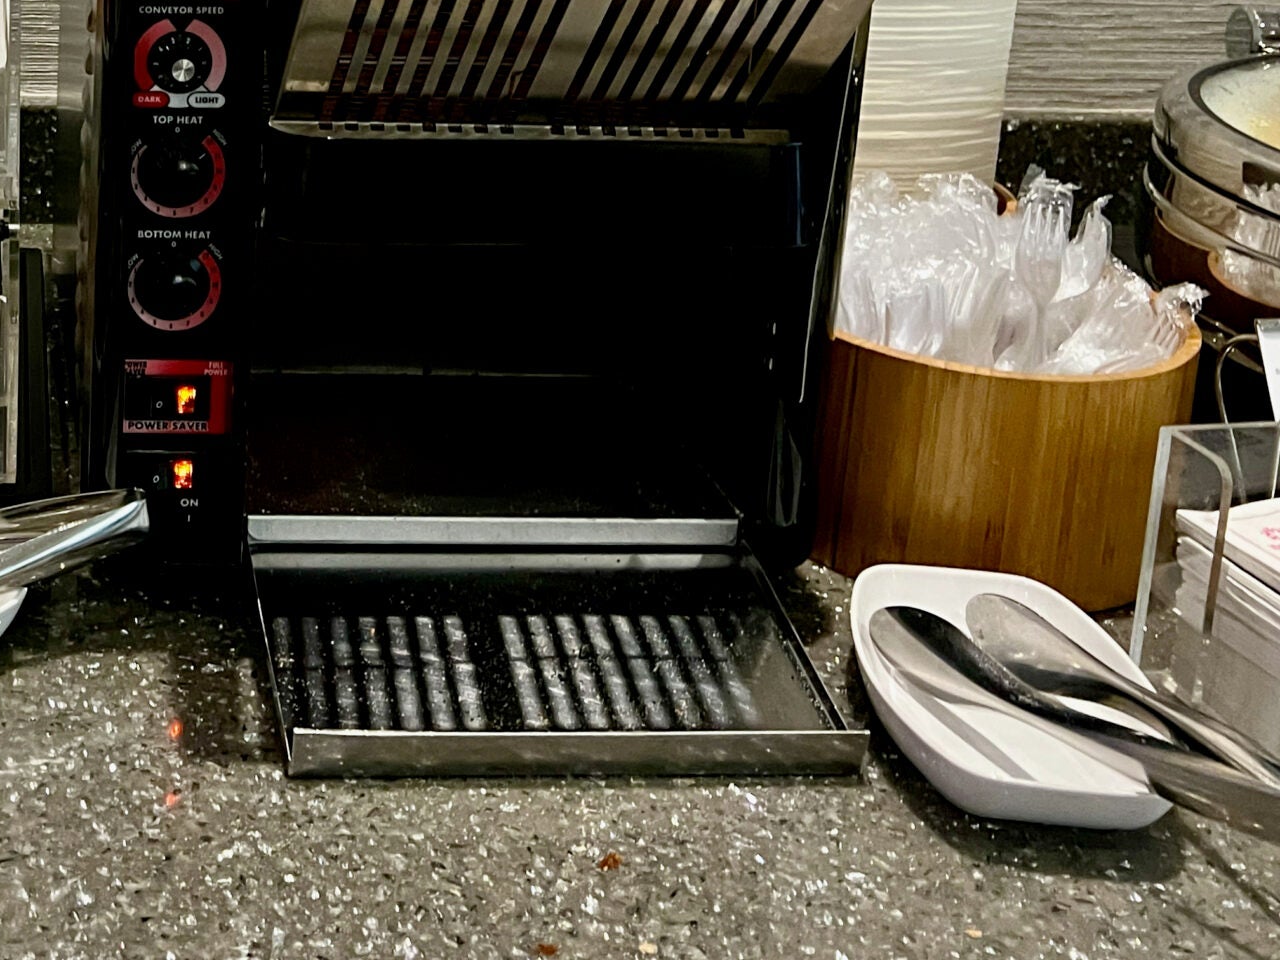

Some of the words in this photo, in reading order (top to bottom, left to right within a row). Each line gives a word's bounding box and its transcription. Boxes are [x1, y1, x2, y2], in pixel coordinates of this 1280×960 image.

[138, 5, 193, 15] CONVEYOR
[196, 6, 224, 15] SPEED
[195, 96, 219, 104] LIGHT
[152, 115, 174, 124] TOP
[176, 115, 204, 125] HEAT
[137, 230, 182, 239] BOTTOM
[185, 230, 211, 239] HEAT
[128, 420, 169, 430] POWER
[172, 420, 208, 430] SAVER
[180, 498, 199, 507] ON
